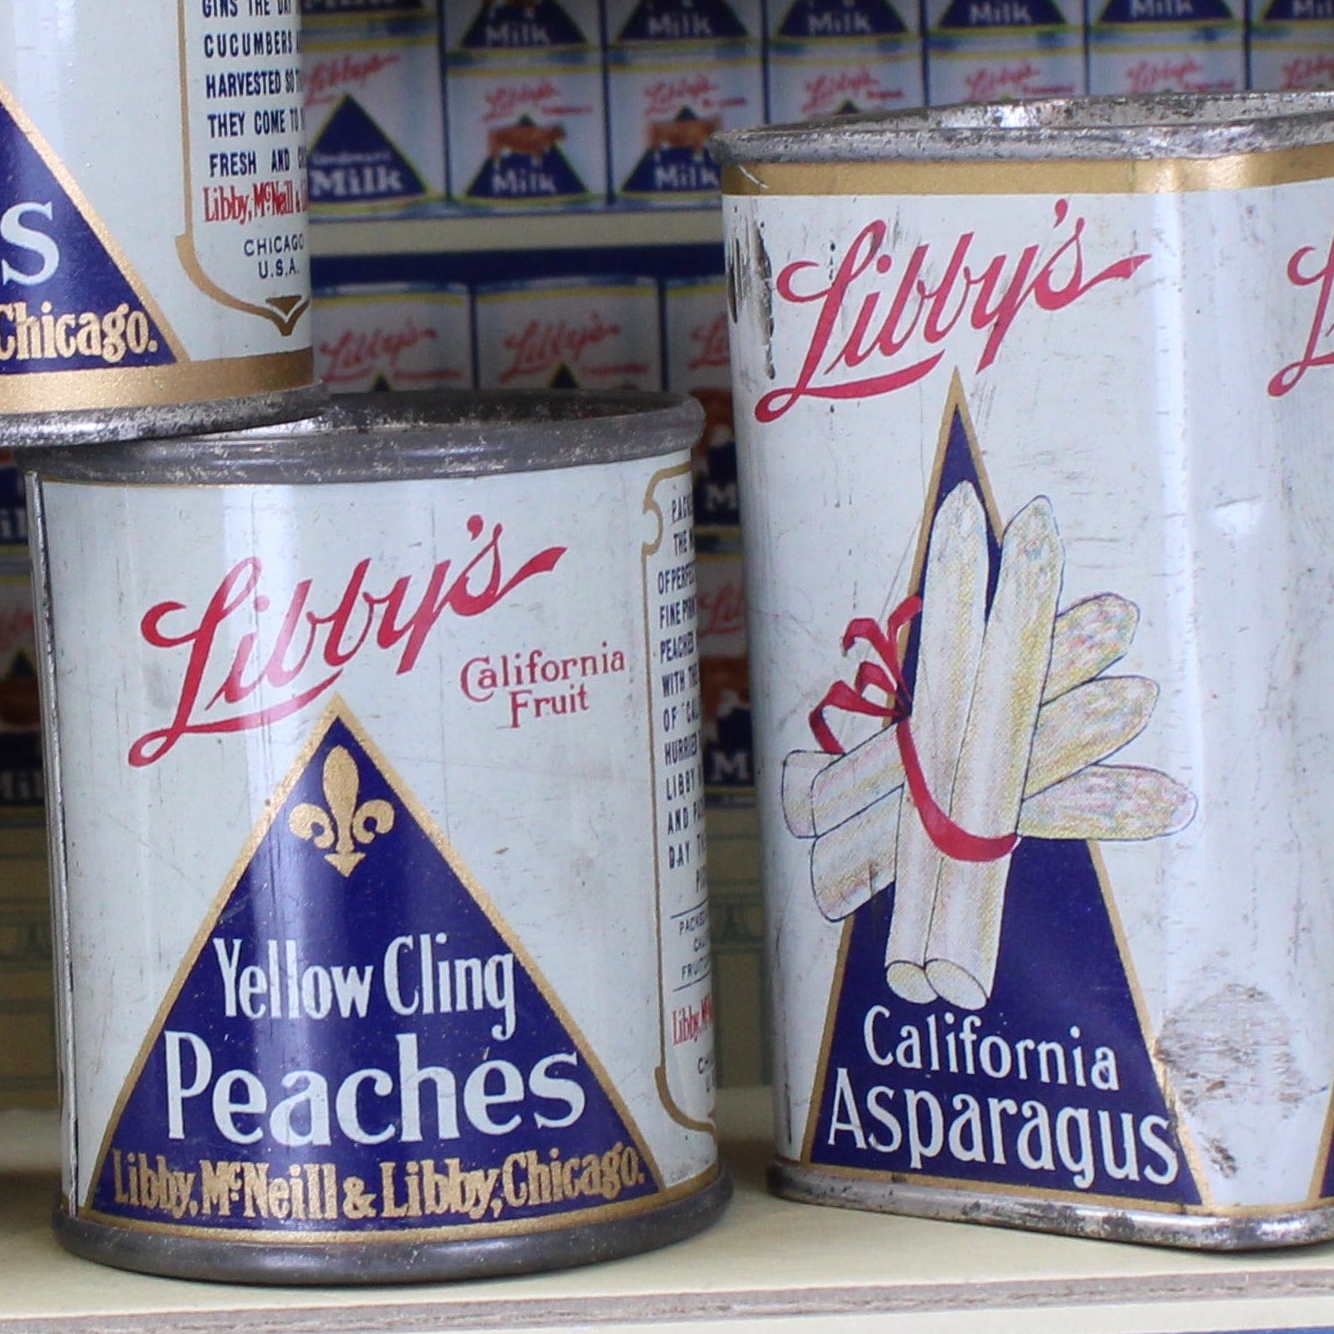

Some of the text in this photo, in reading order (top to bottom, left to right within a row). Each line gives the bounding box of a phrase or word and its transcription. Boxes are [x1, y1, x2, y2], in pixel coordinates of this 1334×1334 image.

[204, 32, 294, 59] CUCUMBERS
[205, 70, 282, 100] HARVESTED
[210, 150, 258, 178] FRESH
[244, 232, 305, 258] CHICAGO
[754, 198, 1149, 425] Libby's
[127, 513, 568, 769] Libby's
[459, 641, 627, 704] California
[507, 687, 590, 729] Fruit
[213, 934, 517, 1041] Yellow Cling
[862, 1005, 1119, 1091] California
[163, 1029, 589, 1149] Peaches
[824, 1066, 1182, 1188] Asparagus
